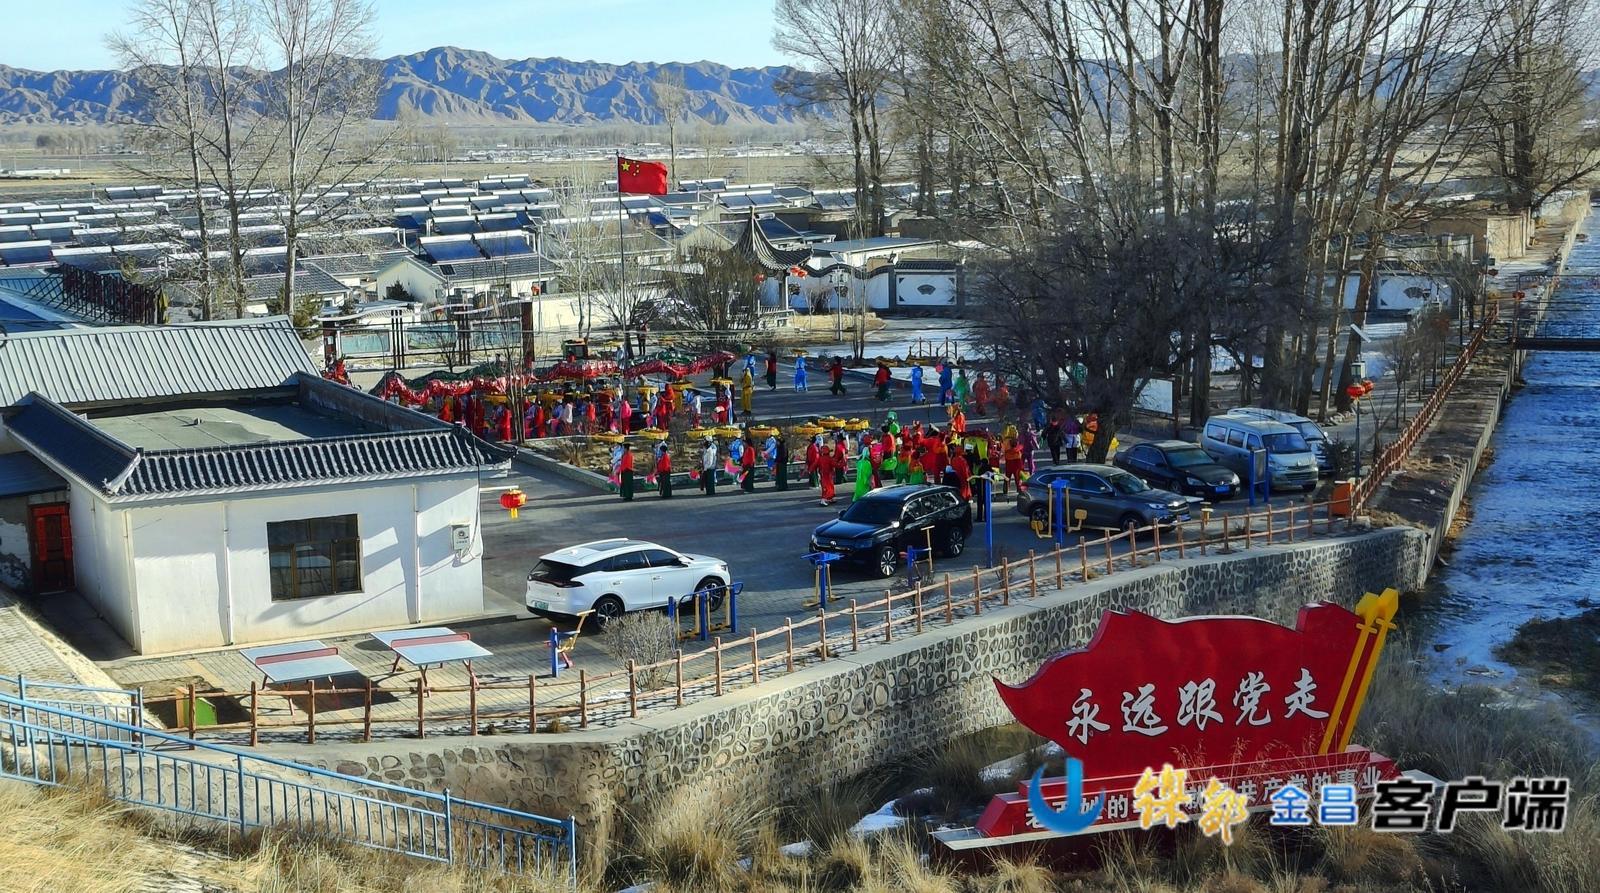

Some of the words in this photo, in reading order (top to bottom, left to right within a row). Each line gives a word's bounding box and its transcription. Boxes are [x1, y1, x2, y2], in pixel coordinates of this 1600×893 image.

[1065, 668, 1329, 745] 永远跟党走
